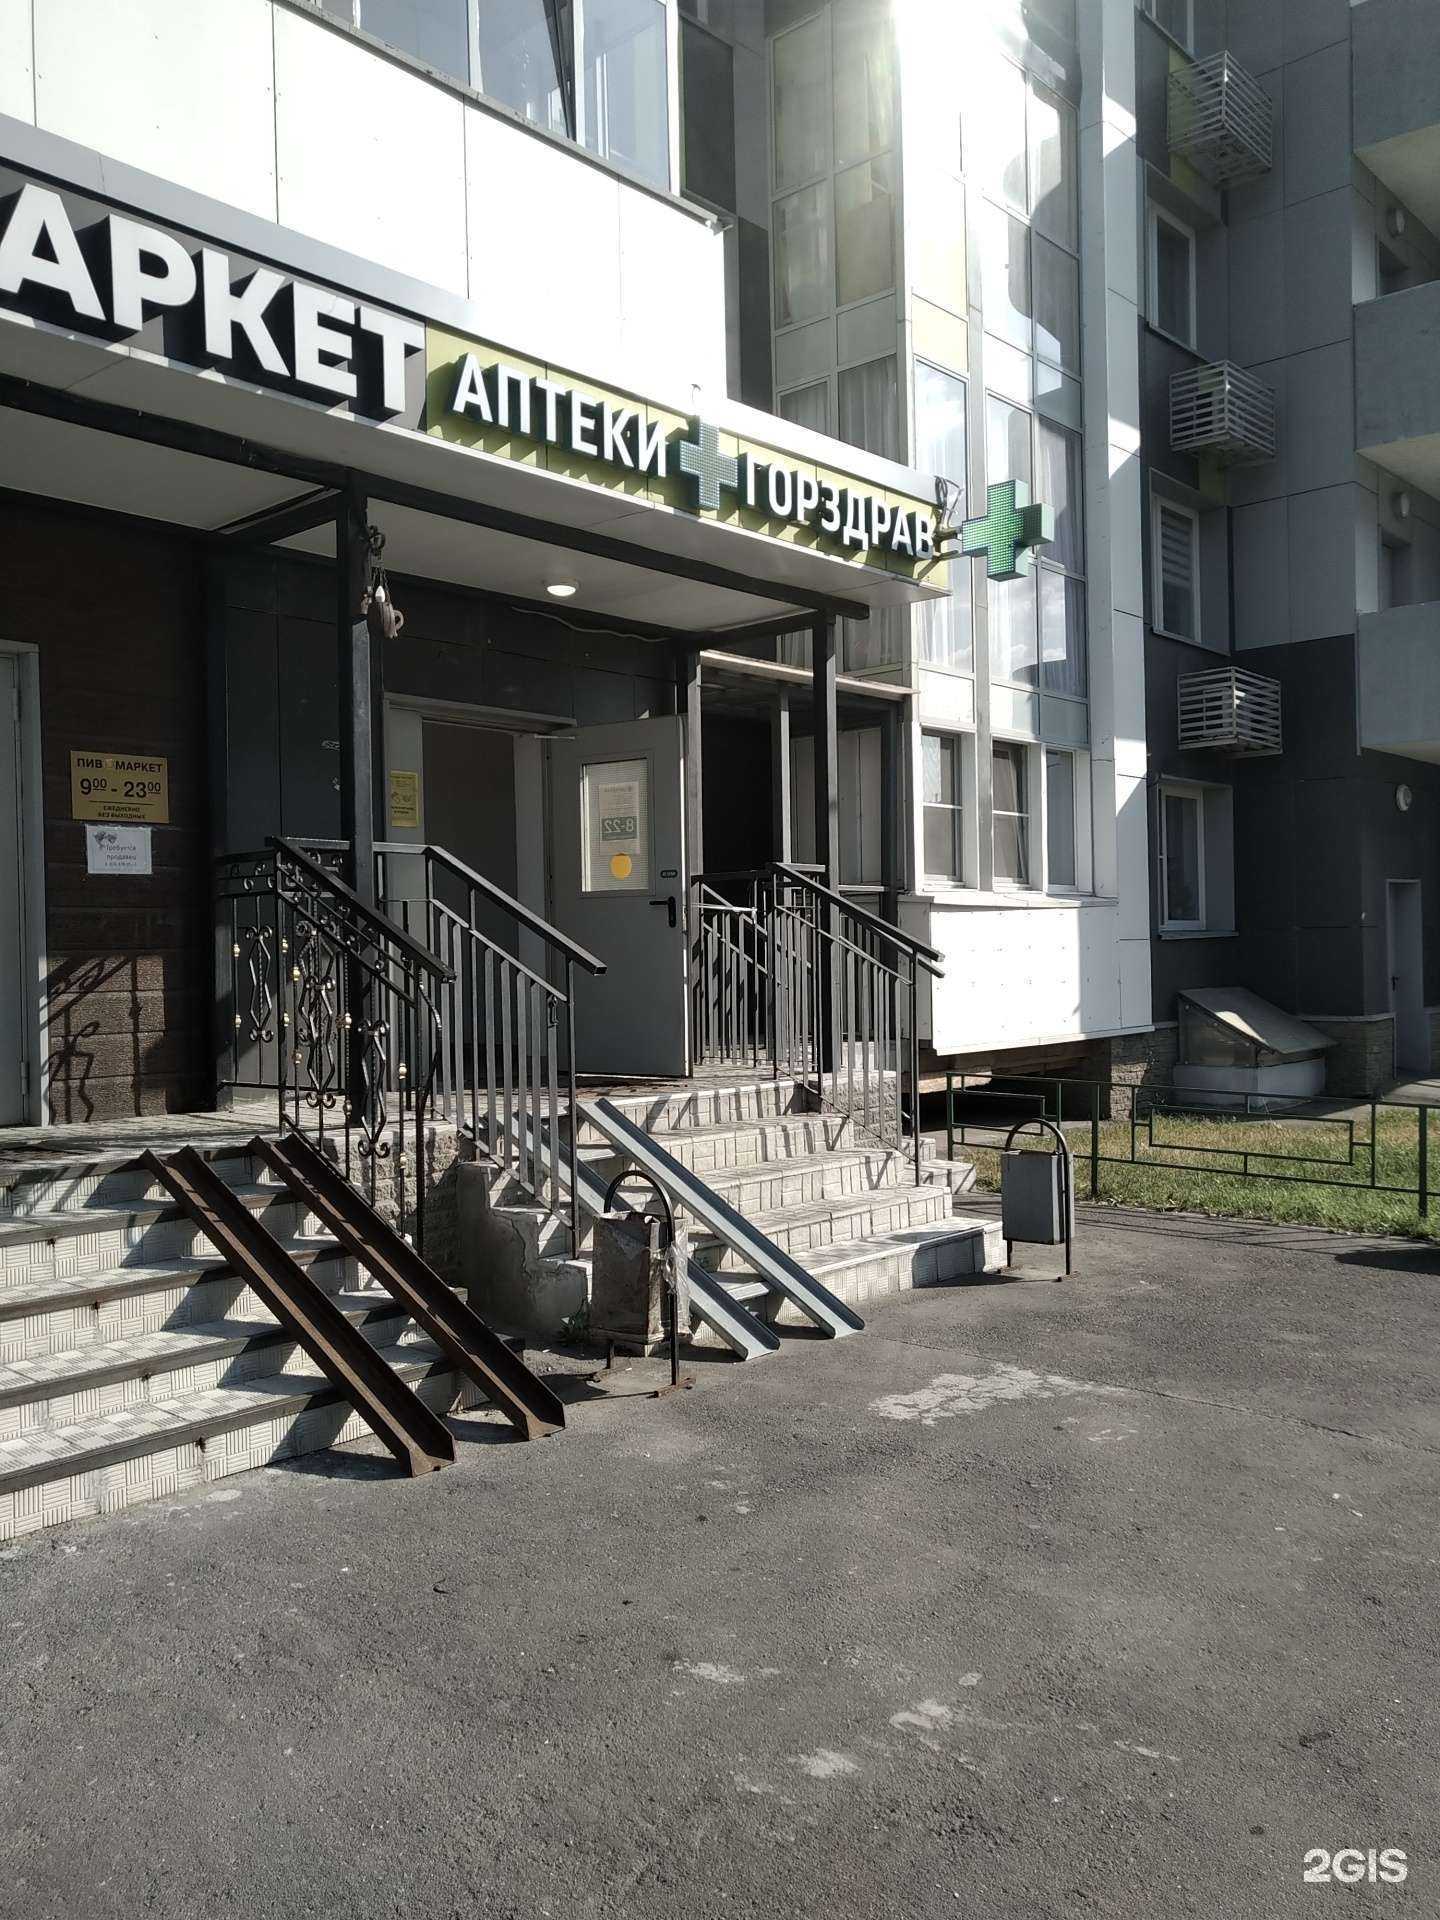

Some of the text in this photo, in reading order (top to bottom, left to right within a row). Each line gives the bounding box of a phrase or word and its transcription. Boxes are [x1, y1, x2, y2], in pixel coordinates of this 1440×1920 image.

[0, 182, 425, 413] АРКЕТ
[452, 352, 935, 560] АПТЕКИ ГОРЗДРАВ
[115, 760, 163, 773] МАРКЕТ
